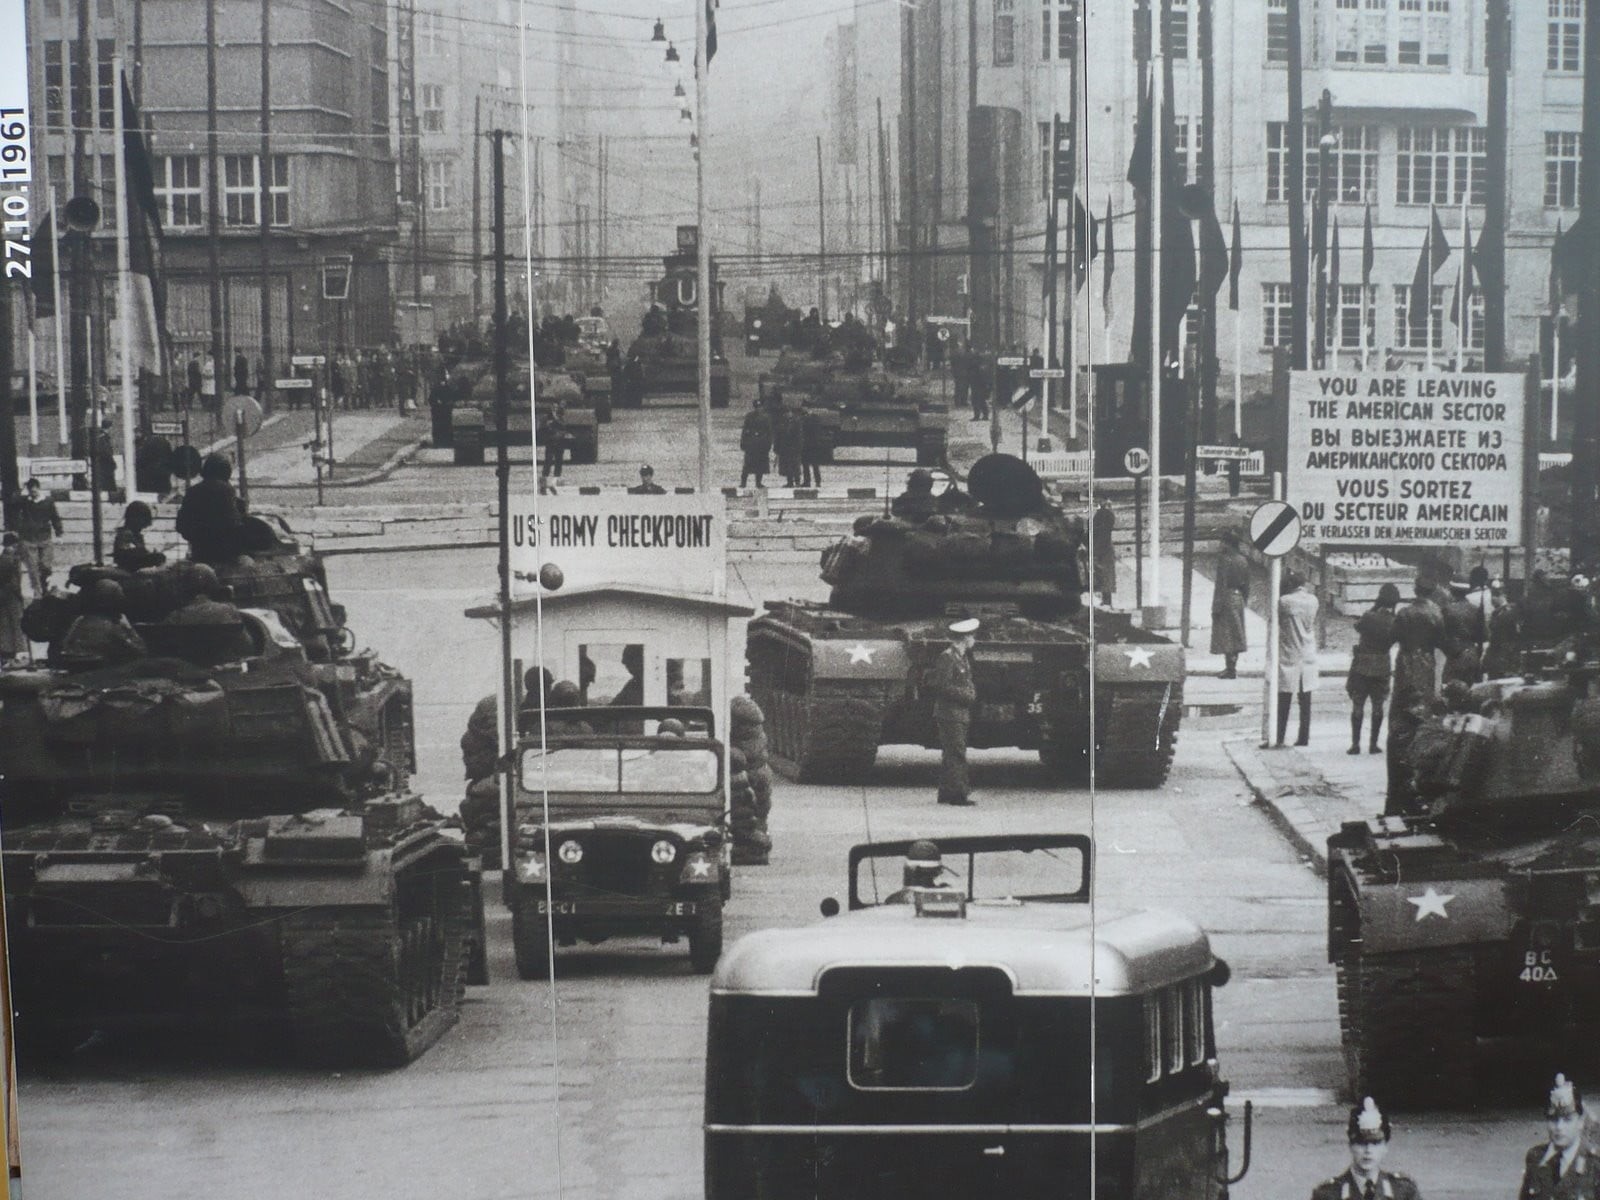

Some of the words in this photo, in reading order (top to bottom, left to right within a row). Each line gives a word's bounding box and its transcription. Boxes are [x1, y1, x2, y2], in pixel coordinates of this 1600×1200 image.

[0, 108, 32, 278] 27.10.1961
[678, 280, 697, 305] U
[1319, 378, 1357, 396] YOU
[1367, 379, 1406, 397] ARE
[1417, 379, 1496, 398] LEAVING
[1308, 401, 1338, 419] THE
[1346, 402, 1433, 420] AMERICAN
[1442, 403, 1506, 421] SECTOR
[1311, 429, 1341, 446] ВЫ
[1351, 429, 1466, 448] ВЫЕЗЖАЕТЕ
[1478, 431, 1502, 449] ИЗ
[1128, 452, 1141, 469] 10
[1306, 452, 1435, 470] АМЕРИКАНСКОГО
[1441, 453, 1507, 471] СЕКТОРА
[1337, 479, 1389, 498] VOUS
[1400, 480, 1472, 499] SORTEZ
[1302, 502, 1325, 520] DU
[1334, 502, 1409, 521] SECTEUR
[1416, 504, 1508, 522] AMERICAIN
[513, 515, 541, 547] US
[550, 515, 599, 547] ARMY
[607, 515, 713, 548] CHECKPOINT
[1320, 525, 1370, 538] VERLASSEN
[1374, 526, 1392, 538] DEN
[1395, 526, 1471, 539] AMERIKANISCHEN
[1475, 527, 1508, 540] SEKTOR
